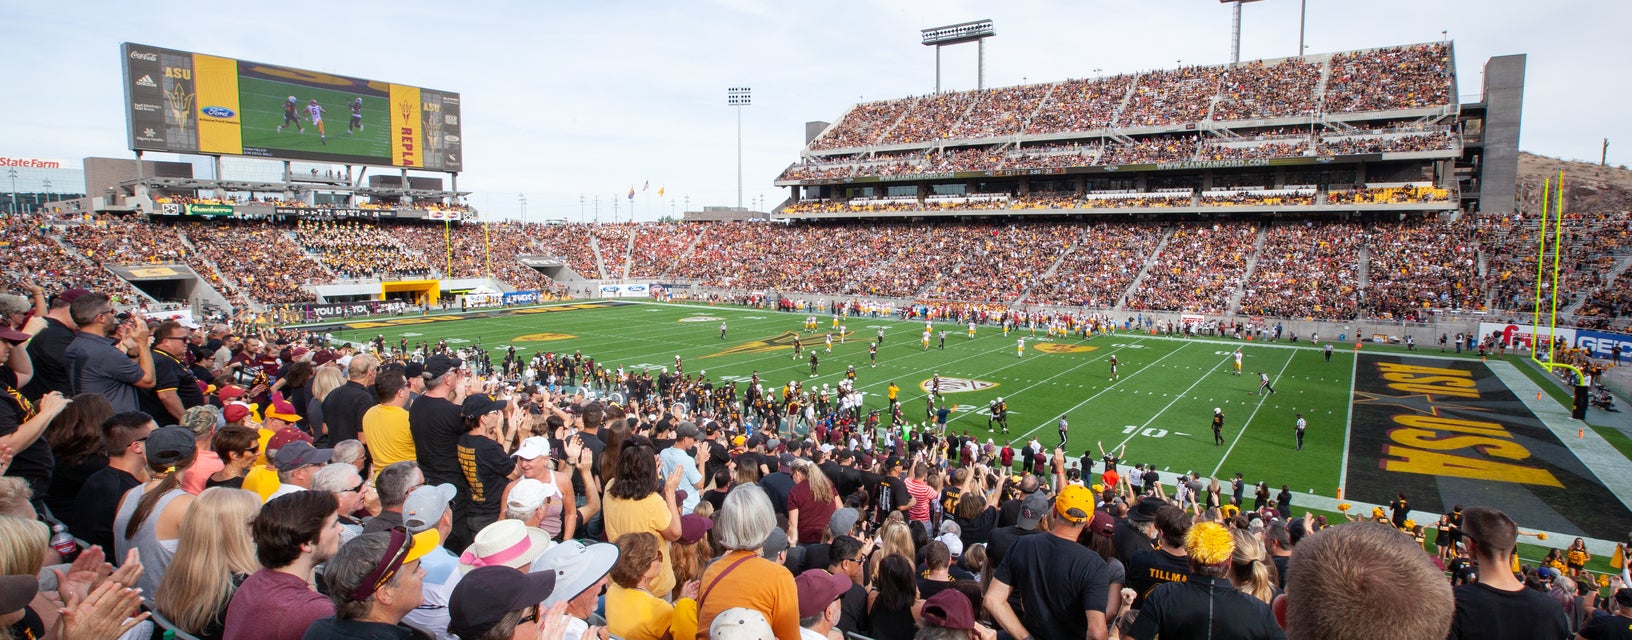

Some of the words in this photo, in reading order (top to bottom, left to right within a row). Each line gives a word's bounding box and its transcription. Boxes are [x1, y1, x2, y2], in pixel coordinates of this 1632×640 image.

[164, 66, 191, 80] ASU
[207, 107, 229, 117] Ford
[423, 102, 441, 112] ASU
[401, 127, 414, 166] REPLA
[0, 157, 30, 167] State
[31, 159, 60, 169] Farm
[1156, 158, 1270, 170] WWW.SANTANFORD.COM
[164, 205, 177, 214] 25
[313, 305, 333, 316] YOU
[1121, 425, 1168, 438] 10
